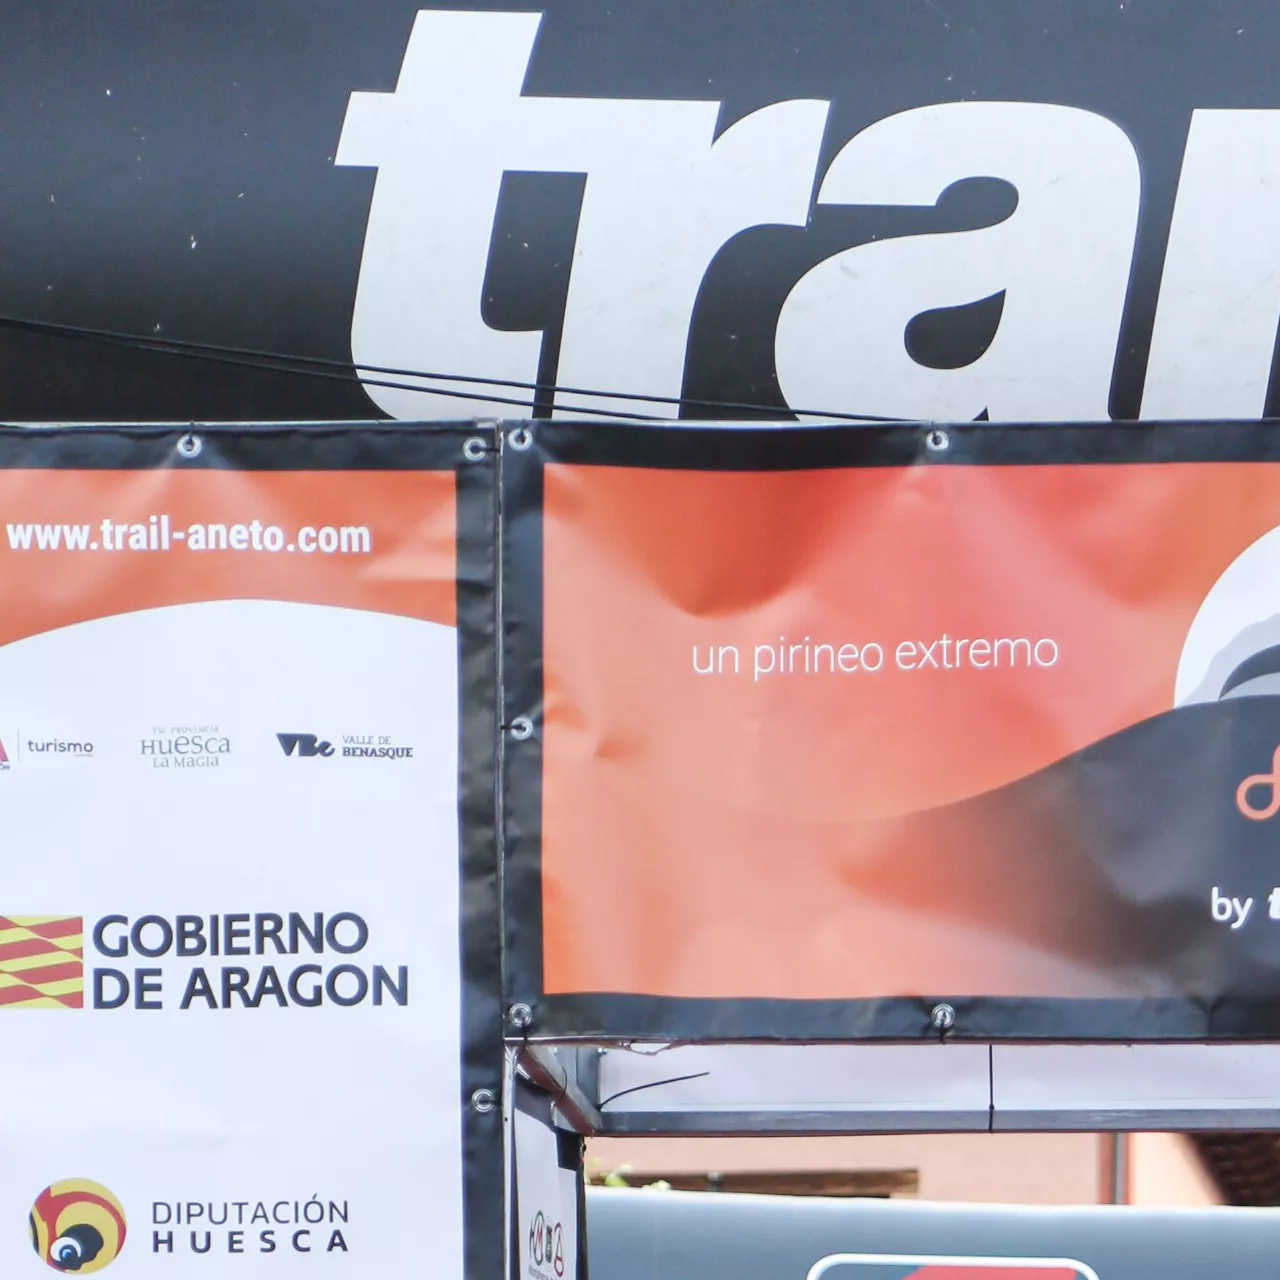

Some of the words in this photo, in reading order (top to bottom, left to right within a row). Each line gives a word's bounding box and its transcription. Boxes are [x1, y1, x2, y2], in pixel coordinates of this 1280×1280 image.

[6, 516, 371, 554] www.trail-aneto.com
[693, 640, 741, 675] un
[754, 635, 884, 683] pirineo
[895, 632, 1058, 671] extremo
[27, 739, 94, 753] turismo
[342, 736, 374, 745] VALLE
[378, 736, 391, 745] DE
[342, 747, 414, 760] BENASQUE
[1211, 887, 1253, 930] by
[92, 911, 369, 958] GOBIERNO
[92, 966, 163, 1010] DE
[180, 965, 409, 1010] ARAGON
[152, 1193, 349, 1225] DIPUTACIÓN
[152, 1229, 349, 1254] HUESCA
